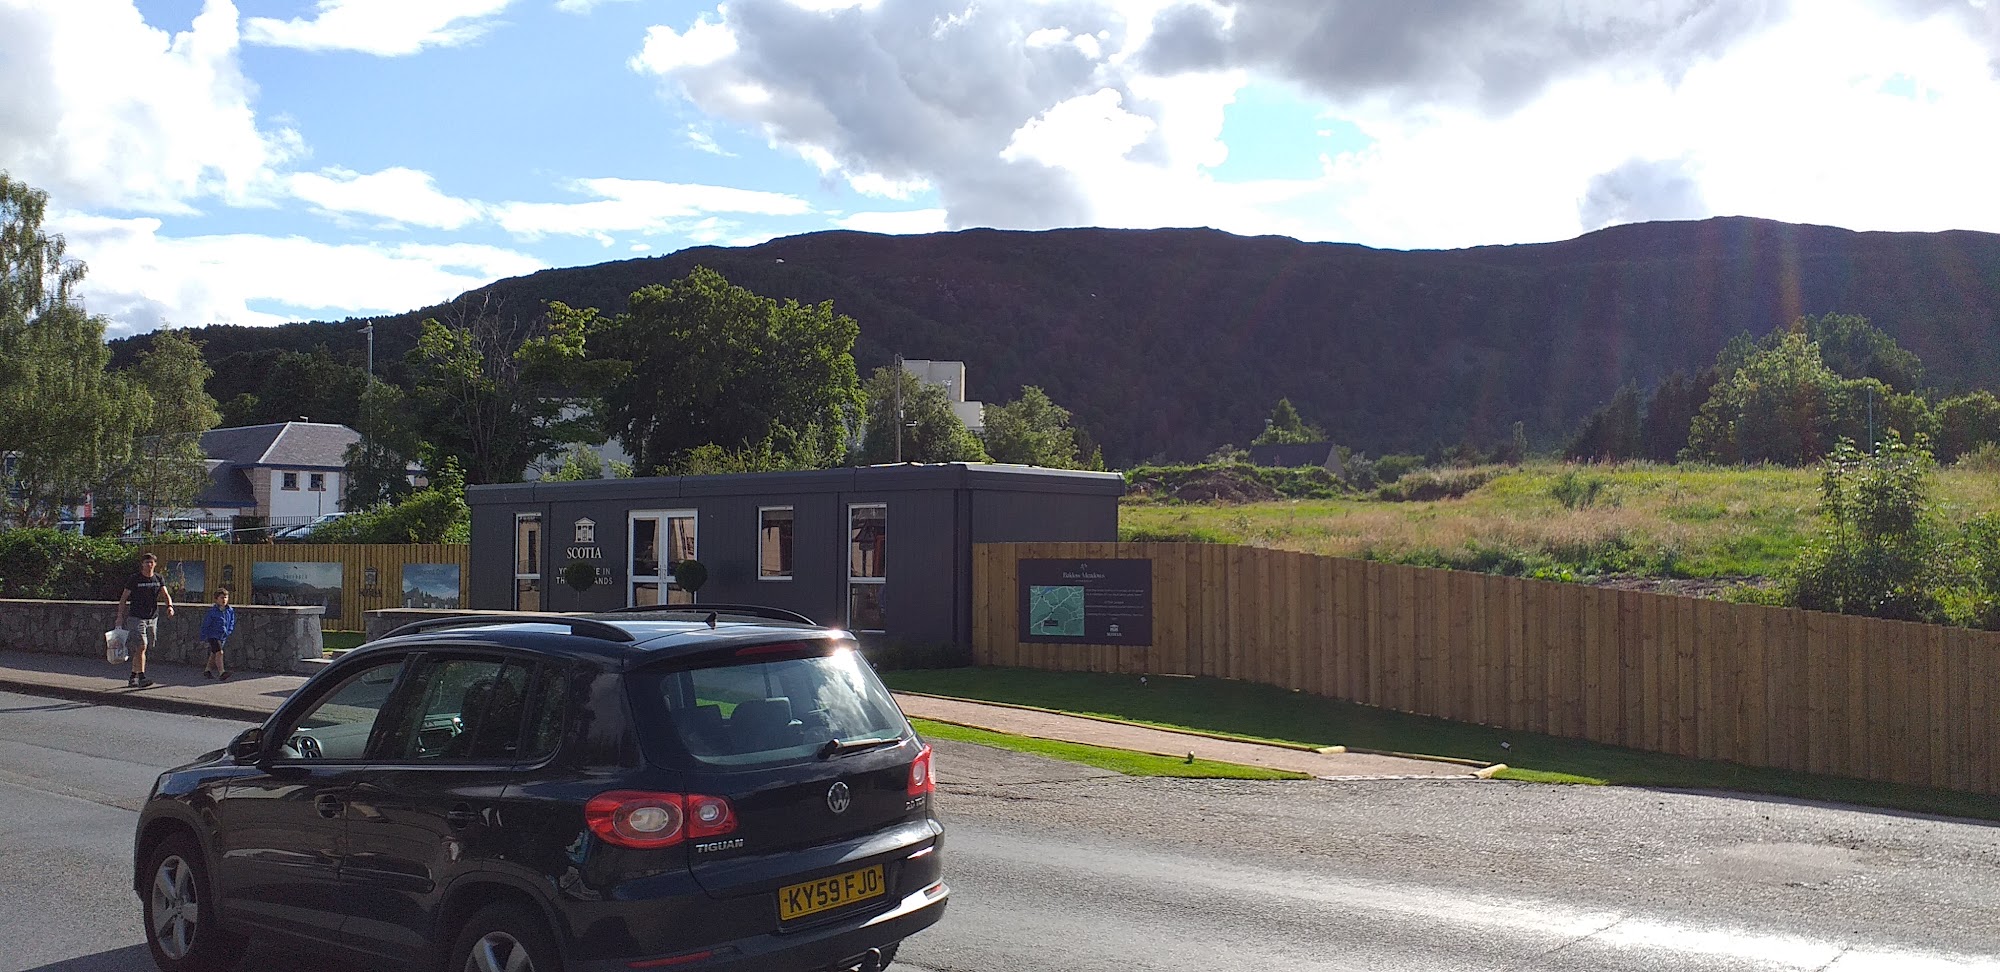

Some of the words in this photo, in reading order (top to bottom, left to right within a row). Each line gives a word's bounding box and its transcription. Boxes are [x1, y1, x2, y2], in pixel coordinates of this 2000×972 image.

[566, 547, 602, 559] SCOTIA
[602, 567, 611, 575] IN
[695, 838, 744, 853] TIGUAN
[788, 879, 840, 914] KY59
[845, 869, 878, 899] FJO
